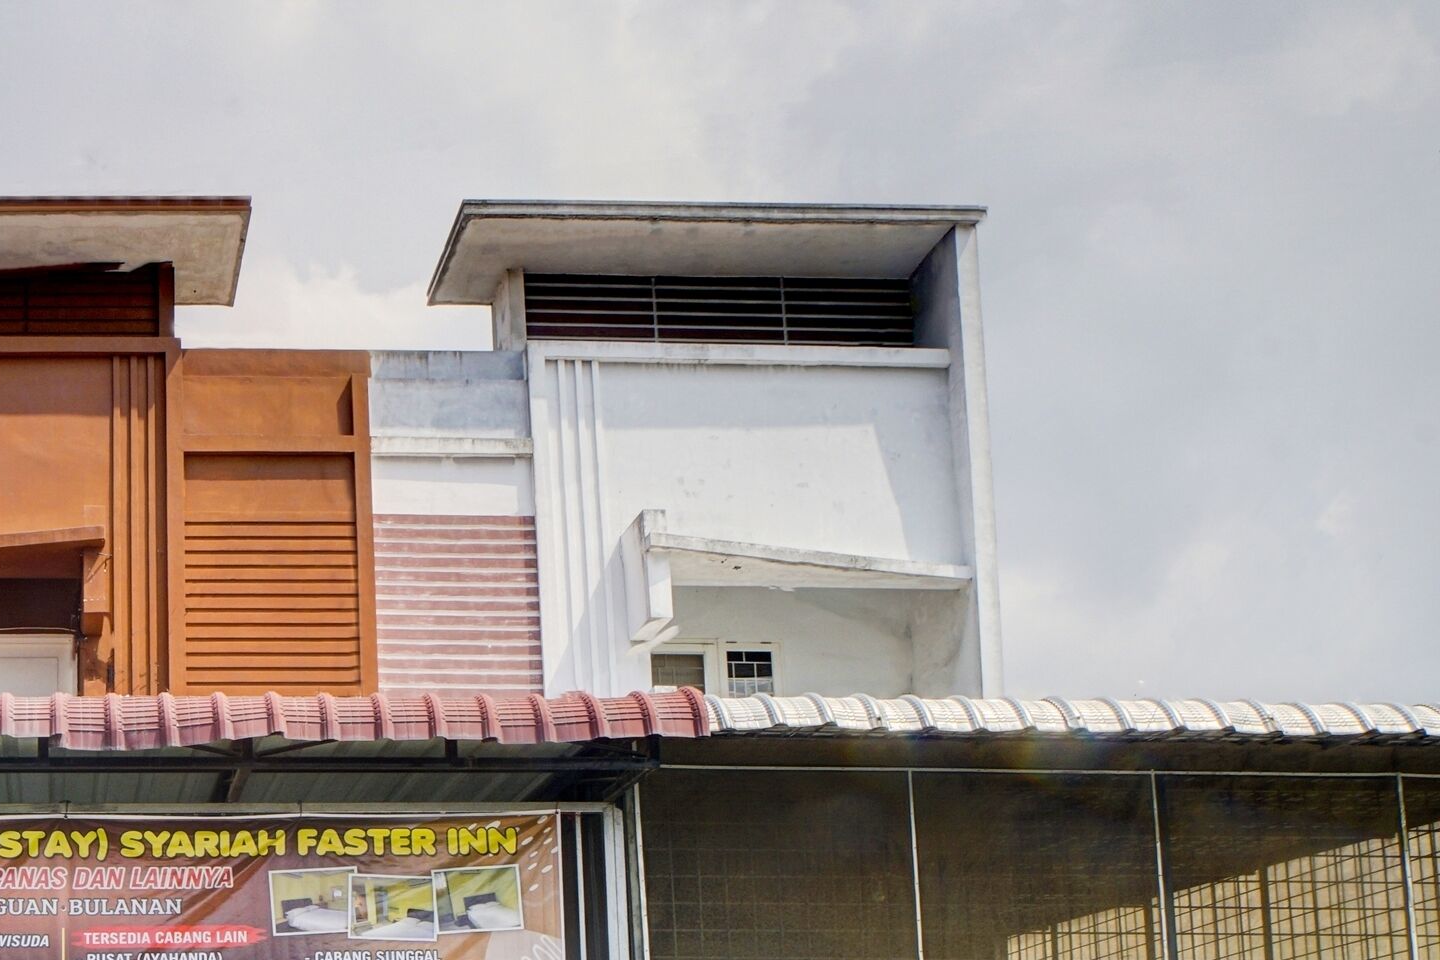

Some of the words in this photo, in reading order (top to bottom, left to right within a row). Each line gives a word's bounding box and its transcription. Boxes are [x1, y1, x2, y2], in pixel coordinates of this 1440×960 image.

[120, 829, 286, 858] SYARIAH
[297, 828, 437, 856] FASTER
[447, 827, 518, 855] INN
[72, 867, 125, 890] DAN
[129, 866, 233, 889] LAINNYA
[69, 898, 182, 916] BULANAN
[83, 931, 151, 945] TERSEDIA
[155, 931, 211, 944] CABANG
[216, 930, 248, 943] LAIN
